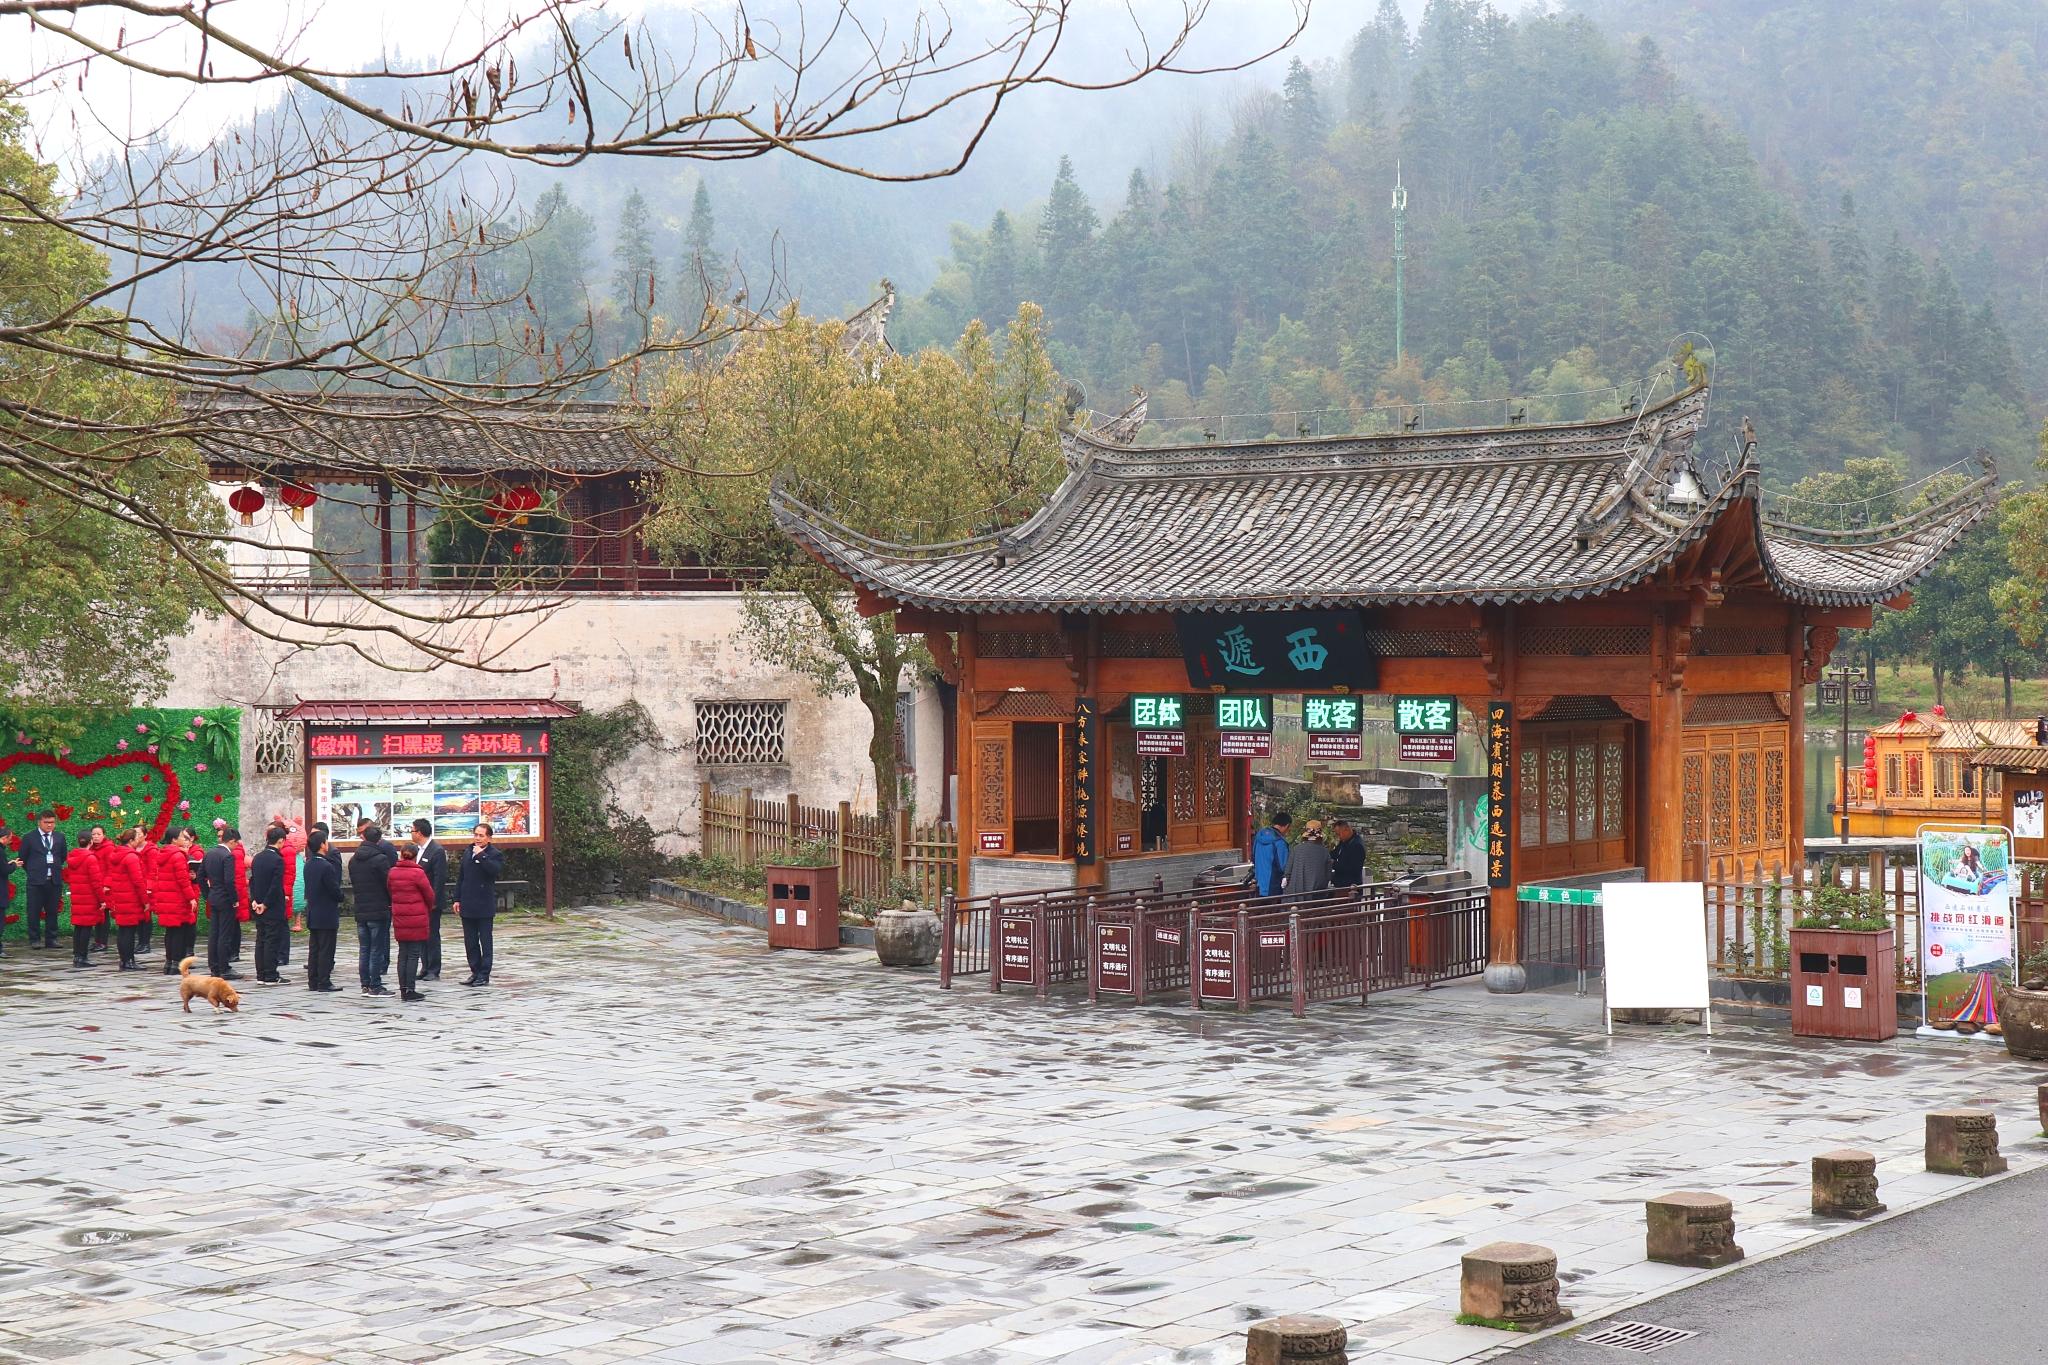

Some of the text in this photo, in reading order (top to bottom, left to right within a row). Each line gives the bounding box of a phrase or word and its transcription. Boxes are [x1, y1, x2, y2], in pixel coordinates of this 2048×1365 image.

[1219, 699, 1267, 728] 团队
[1305, 700, 1356, 730] 散客
[1397, 700, 1451, 731] 散客
[311, 733, 548, 756] 徽州；扫黑恶，净环境，
[1930, 912, 2004, 926] 挑战网红滑道
[1005, 935, 1029, 945] 文明礼让
[1157, 931, 1179, 942] 通道关闭
[1261, 937, 1284, 945] 通道关闭
[1102, 943, 1128, 952] 文明礼让
[1204, 948, 1231, 958] 文明礼让
[1004, 954, 1029, 963] 有序通行
[1102, 962, 1128, 971] 有序通行
[1204, 968, 1231, 978] 有序通行
